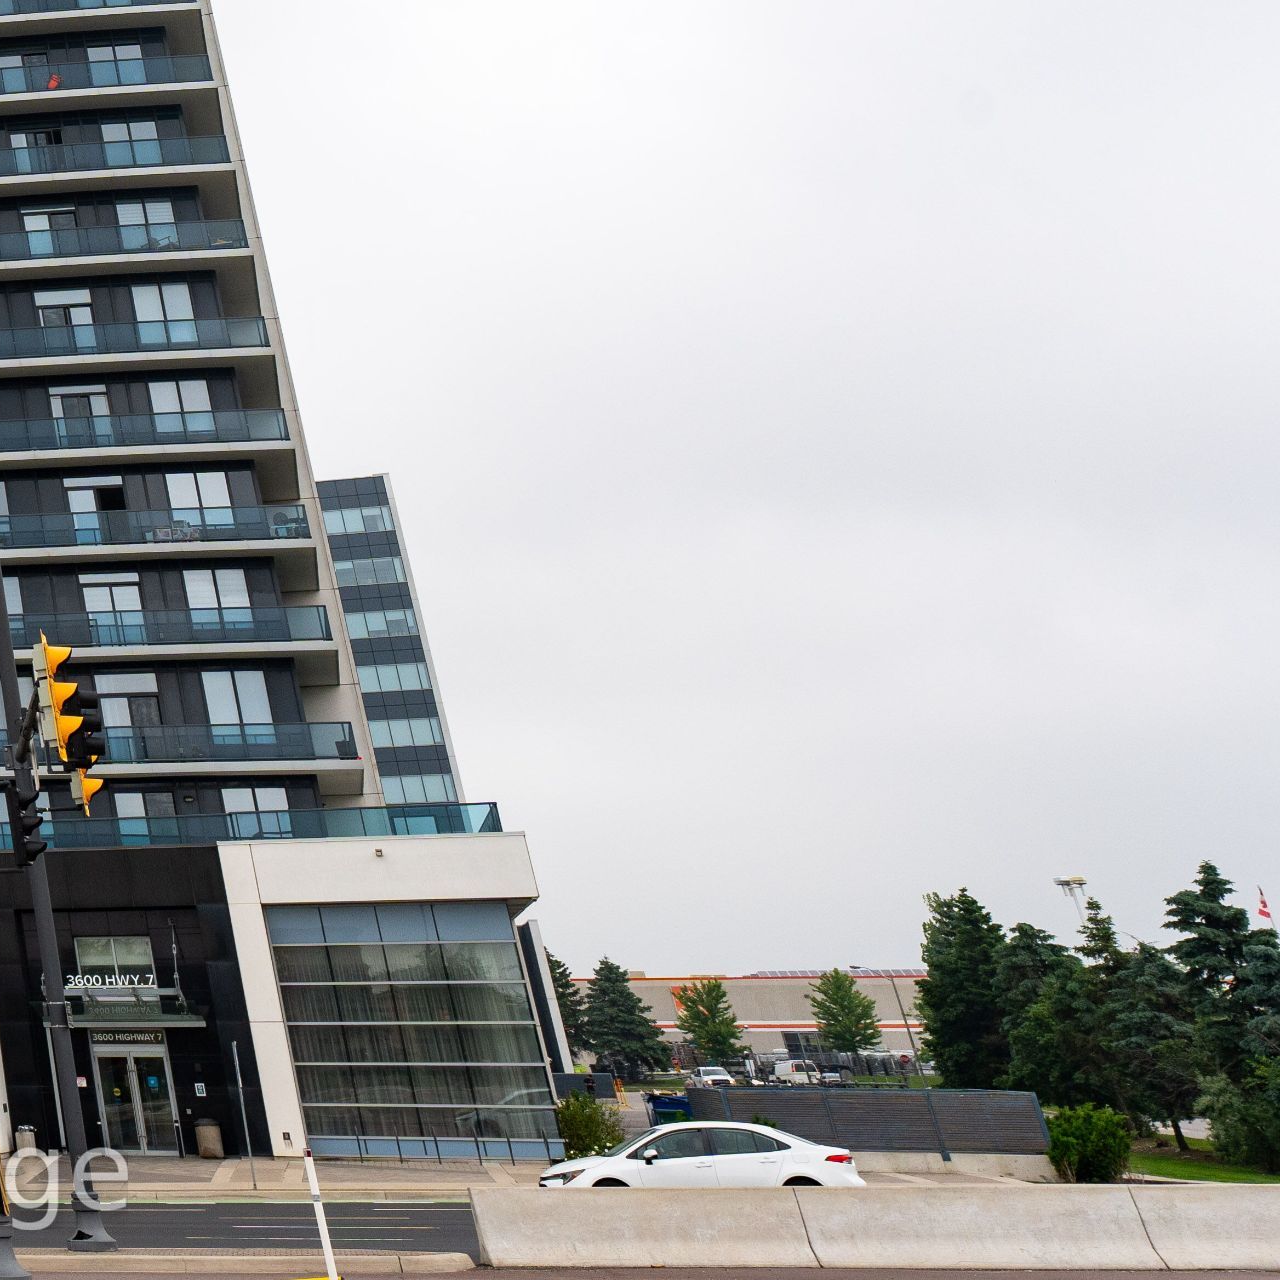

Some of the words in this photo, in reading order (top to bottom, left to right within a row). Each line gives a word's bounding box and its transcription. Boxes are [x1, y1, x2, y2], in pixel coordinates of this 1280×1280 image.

[66, 974, 102, 987] 3600
[105, 974, 144, 986] HWY.
[145, 974, 154, 986] 7
[92, 1033, 114, 1041] 3600
[115, 1033, 156, 1041] HIGHWAY
[156, 1033, 162, 1041] 7
